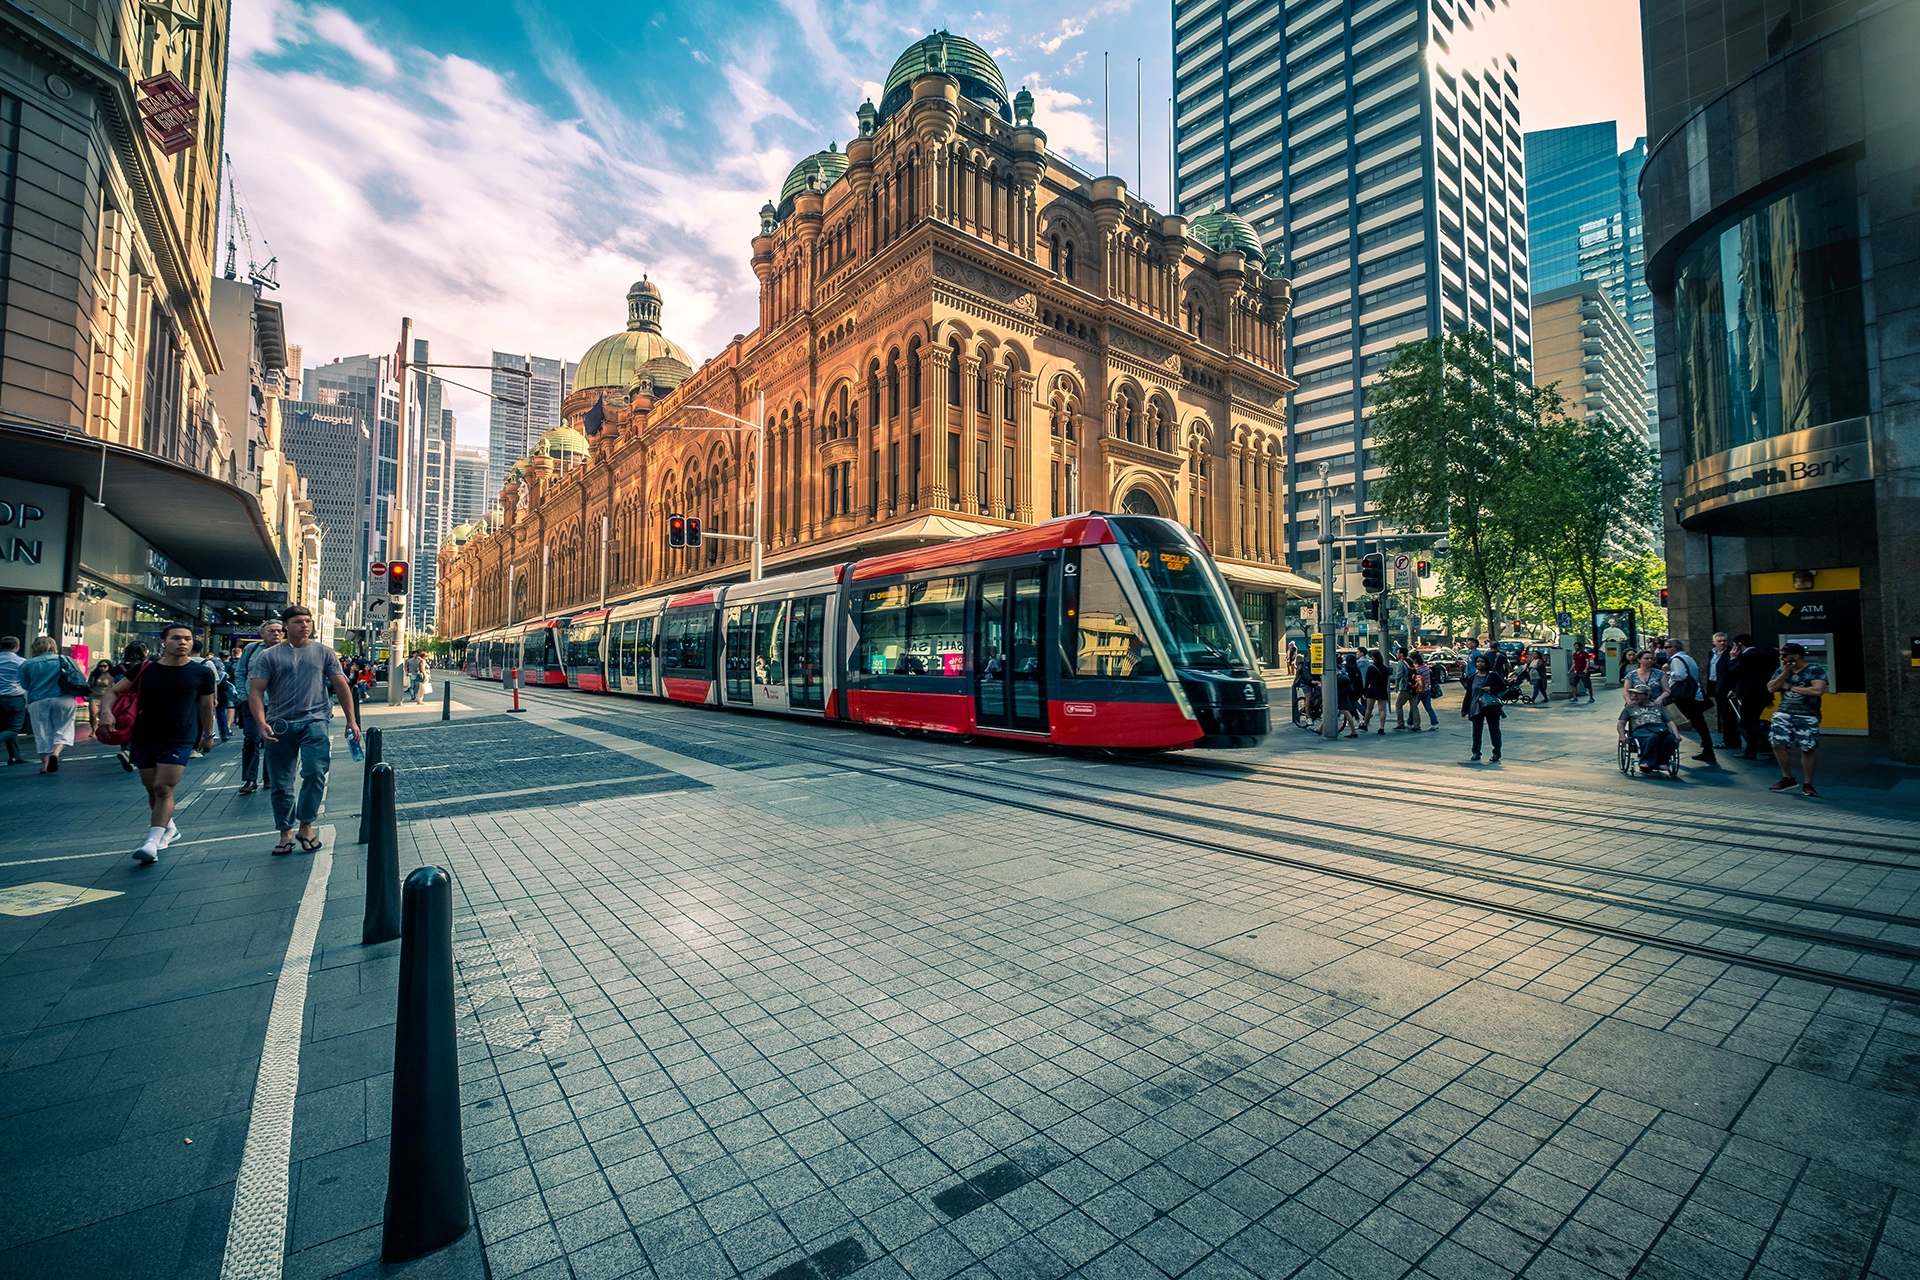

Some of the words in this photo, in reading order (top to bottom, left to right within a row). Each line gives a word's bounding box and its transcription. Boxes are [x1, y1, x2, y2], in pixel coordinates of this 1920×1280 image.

[140, 93, 172, 115] BAR
[164, 89, 185, 106] &
[153, 105, 196, 133] GRILL
[311, 412, 353, 426] Ausgrid
[1789, 455, 1851, 481] Bank
[1136, 549, 1150, 568] L2
[1800, 605, 1824, 613] ATM
[63, 607, 85, 638] SALE
